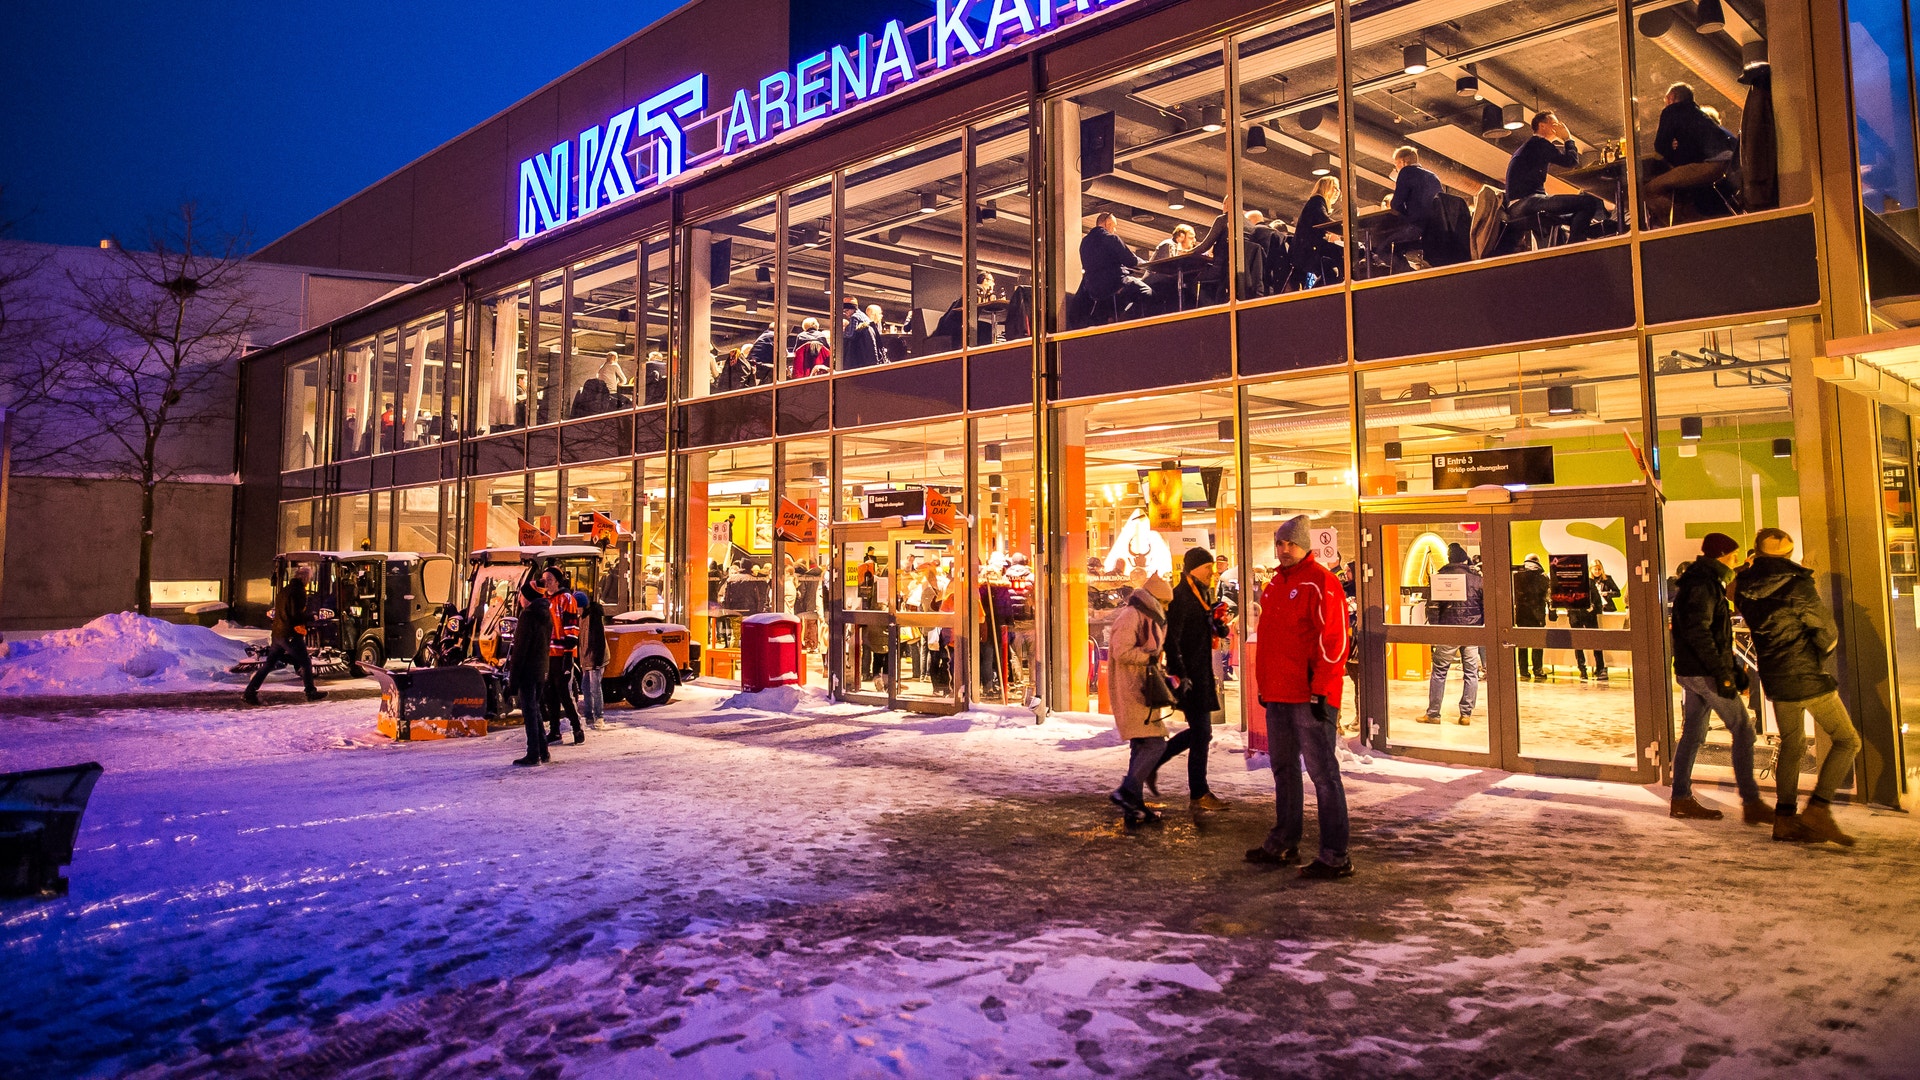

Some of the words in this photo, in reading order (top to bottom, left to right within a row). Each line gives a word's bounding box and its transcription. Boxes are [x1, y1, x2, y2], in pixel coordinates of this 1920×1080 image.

[517, 71, 709, 241] NKT
[723, 19, 915, 154] ARENA
[1447, 456, 1467, 465] Entré
[1468, 456, 1473, 464] 3
[930, 499, 952, 507] GAME
[783, 512, 805, 521] GAME
[784, 519, 800, 527] DAY
